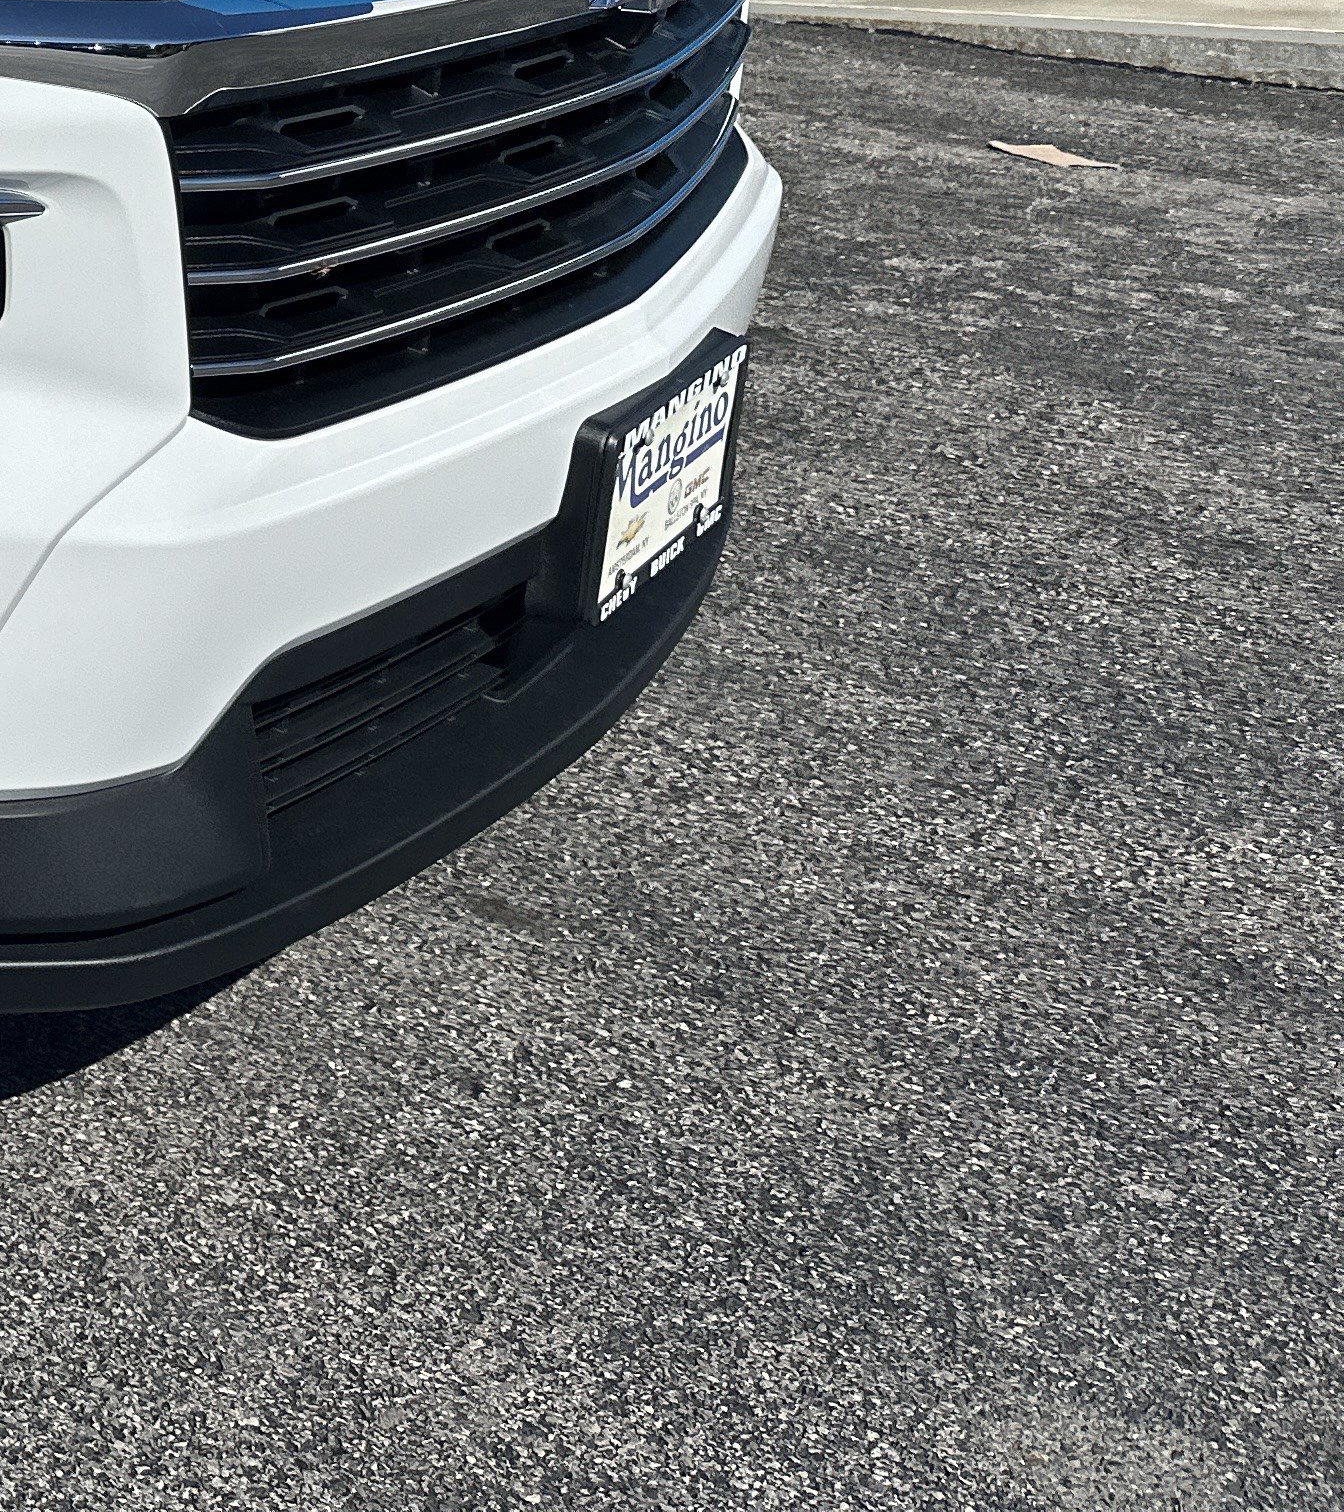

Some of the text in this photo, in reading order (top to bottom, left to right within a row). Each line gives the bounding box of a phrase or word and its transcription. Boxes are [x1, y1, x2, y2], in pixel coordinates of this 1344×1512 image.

[620, 344, 748, 456] MANGINO
[615, 391, 729, 508] Mangino
[684, 467, 710, 499] GMC
[650, 535, 686, 578] BUICK
